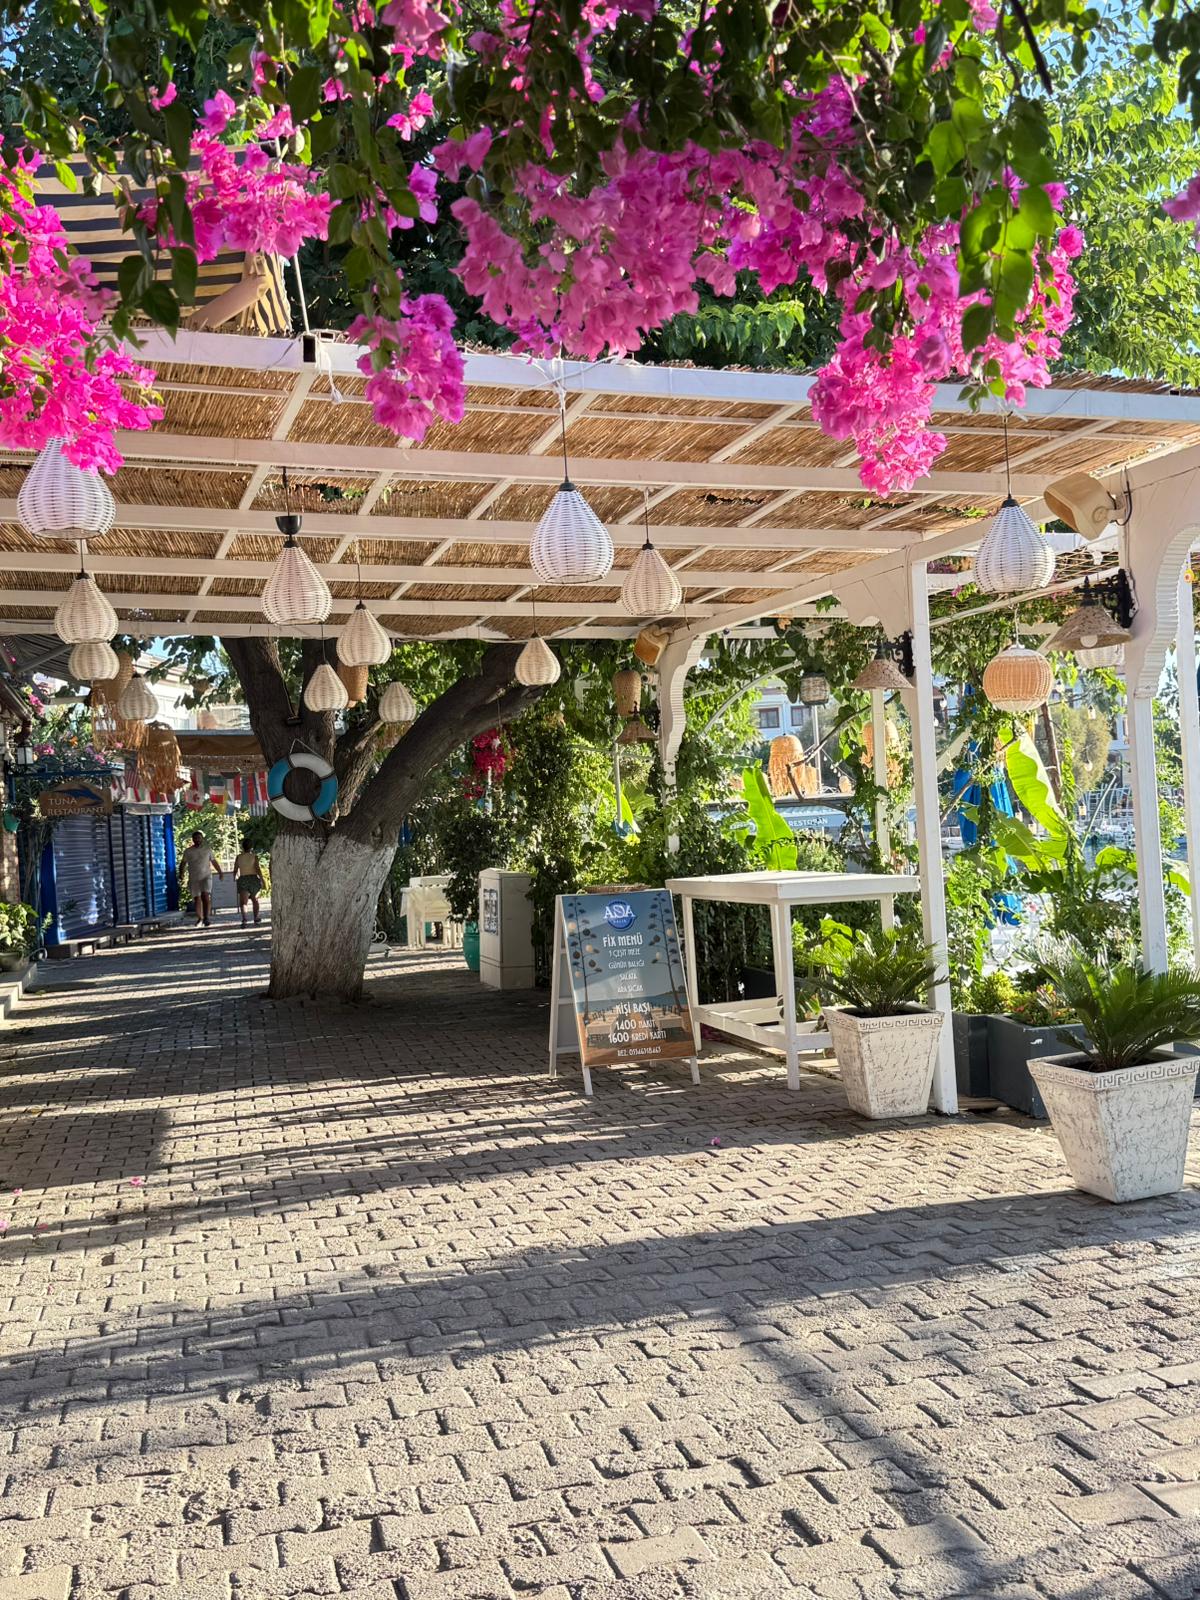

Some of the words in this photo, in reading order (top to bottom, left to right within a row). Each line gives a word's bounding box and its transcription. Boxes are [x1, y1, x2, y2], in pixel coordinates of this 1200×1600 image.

[48, 807, 104, 816] RESTAURANT
[603, 935, 616, 947] FİX
[618, 933, 643, 946] MENÜ
[616, 1002, 631, 1016] KİŞİ
[633, 1002, 650, 1014] BAŞI
[616, 1019, 636, 1030] 1400
[608, 1031, 629, 1043] 1600
[650, 1031, 666, 1040] KARTI
